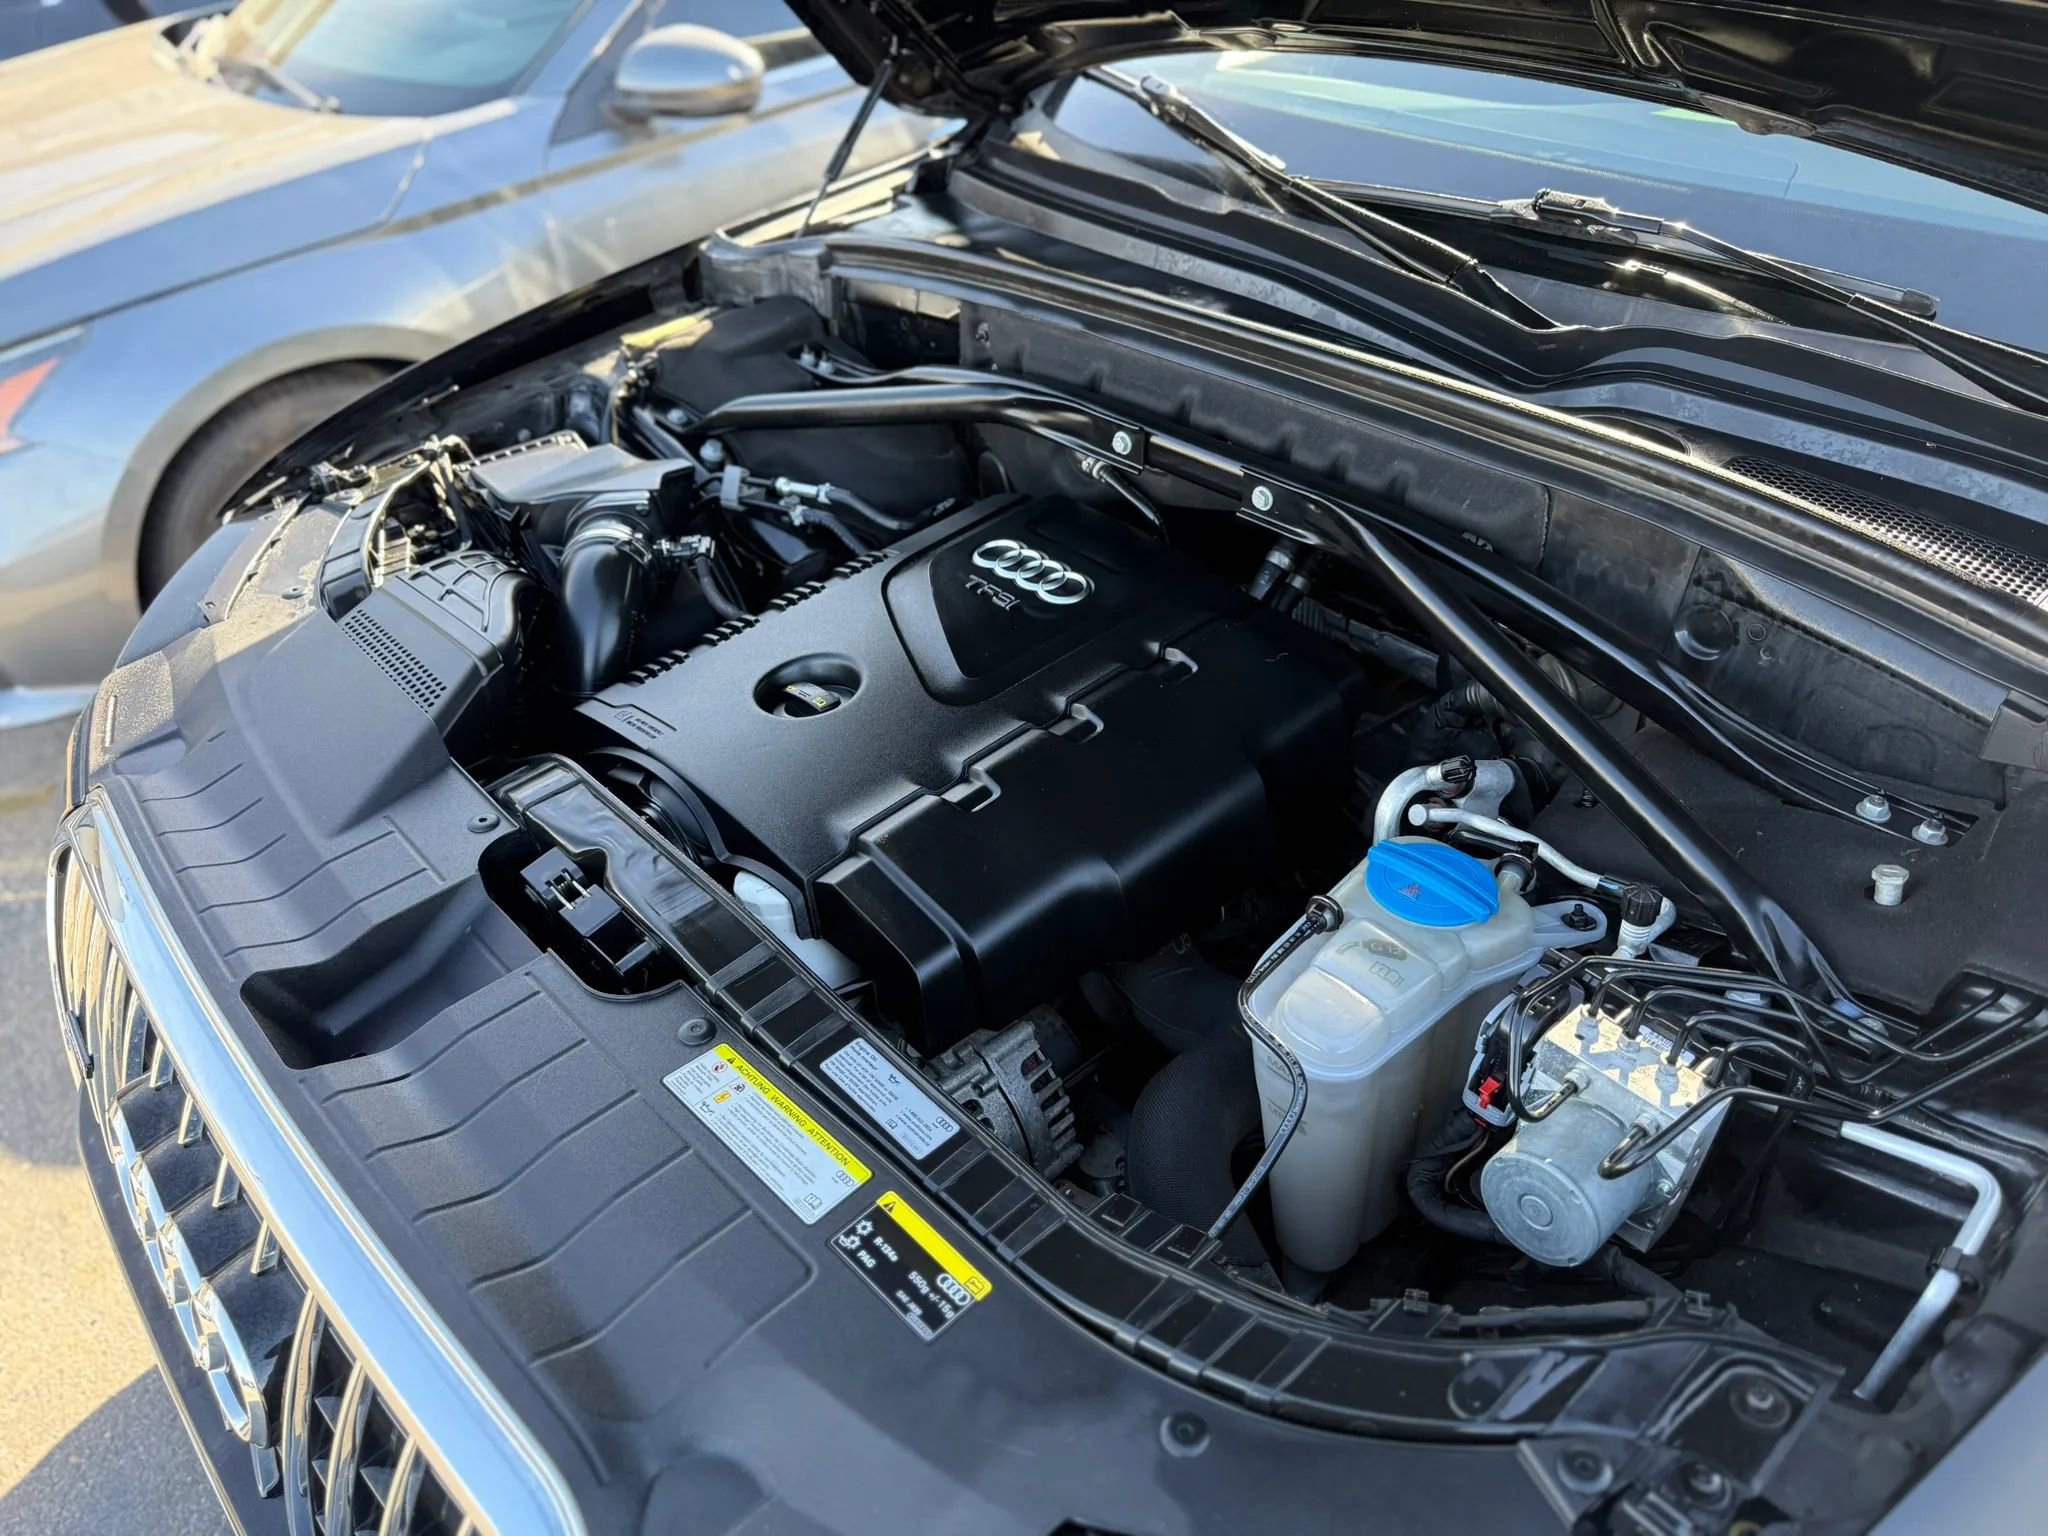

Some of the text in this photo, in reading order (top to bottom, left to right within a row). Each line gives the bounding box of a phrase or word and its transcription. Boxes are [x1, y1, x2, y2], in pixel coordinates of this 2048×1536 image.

[965, 575, 1020, 610] TFSI
[848, 1044, 862, 1056] Huile
[853, 1040, 871, 1055] Engine
[734, 1063, 771, 1094] ACHTUNG
[769, 1093, 808, 1127] WARNING
[805, 1126, 851, 1166] ATTENTION
[855, 1249, 876, 1268] PAG
[871, 1235, 901, 1262] R-134a
